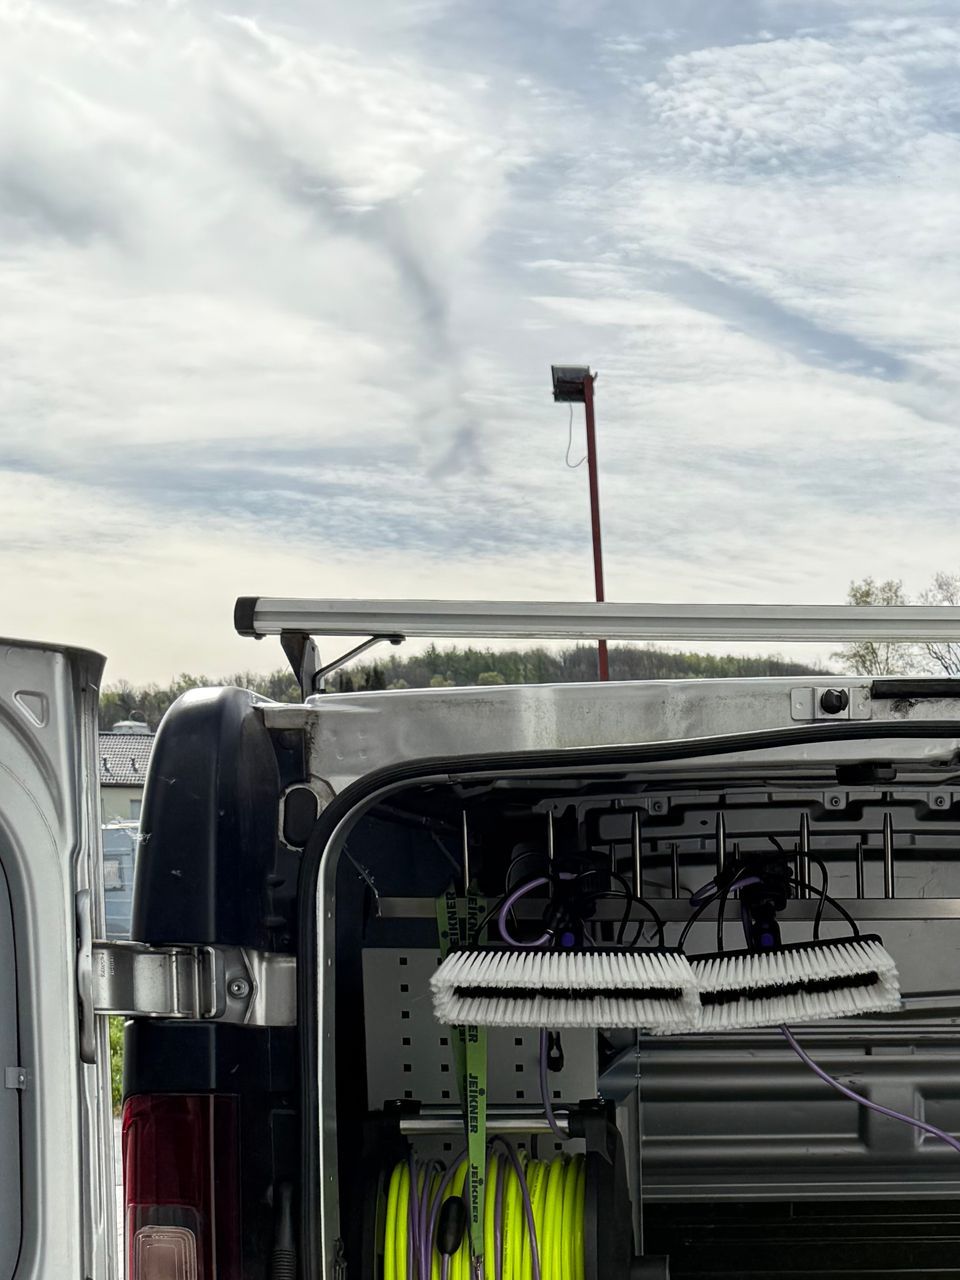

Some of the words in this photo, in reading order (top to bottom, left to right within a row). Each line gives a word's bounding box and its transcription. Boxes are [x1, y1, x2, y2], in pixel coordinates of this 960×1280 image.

[441, 891, 460, 946] EIKNER
[468, 1072, 486, 1134] JEIKNER
[471, 1163, 484, 1223] JEIKNER
